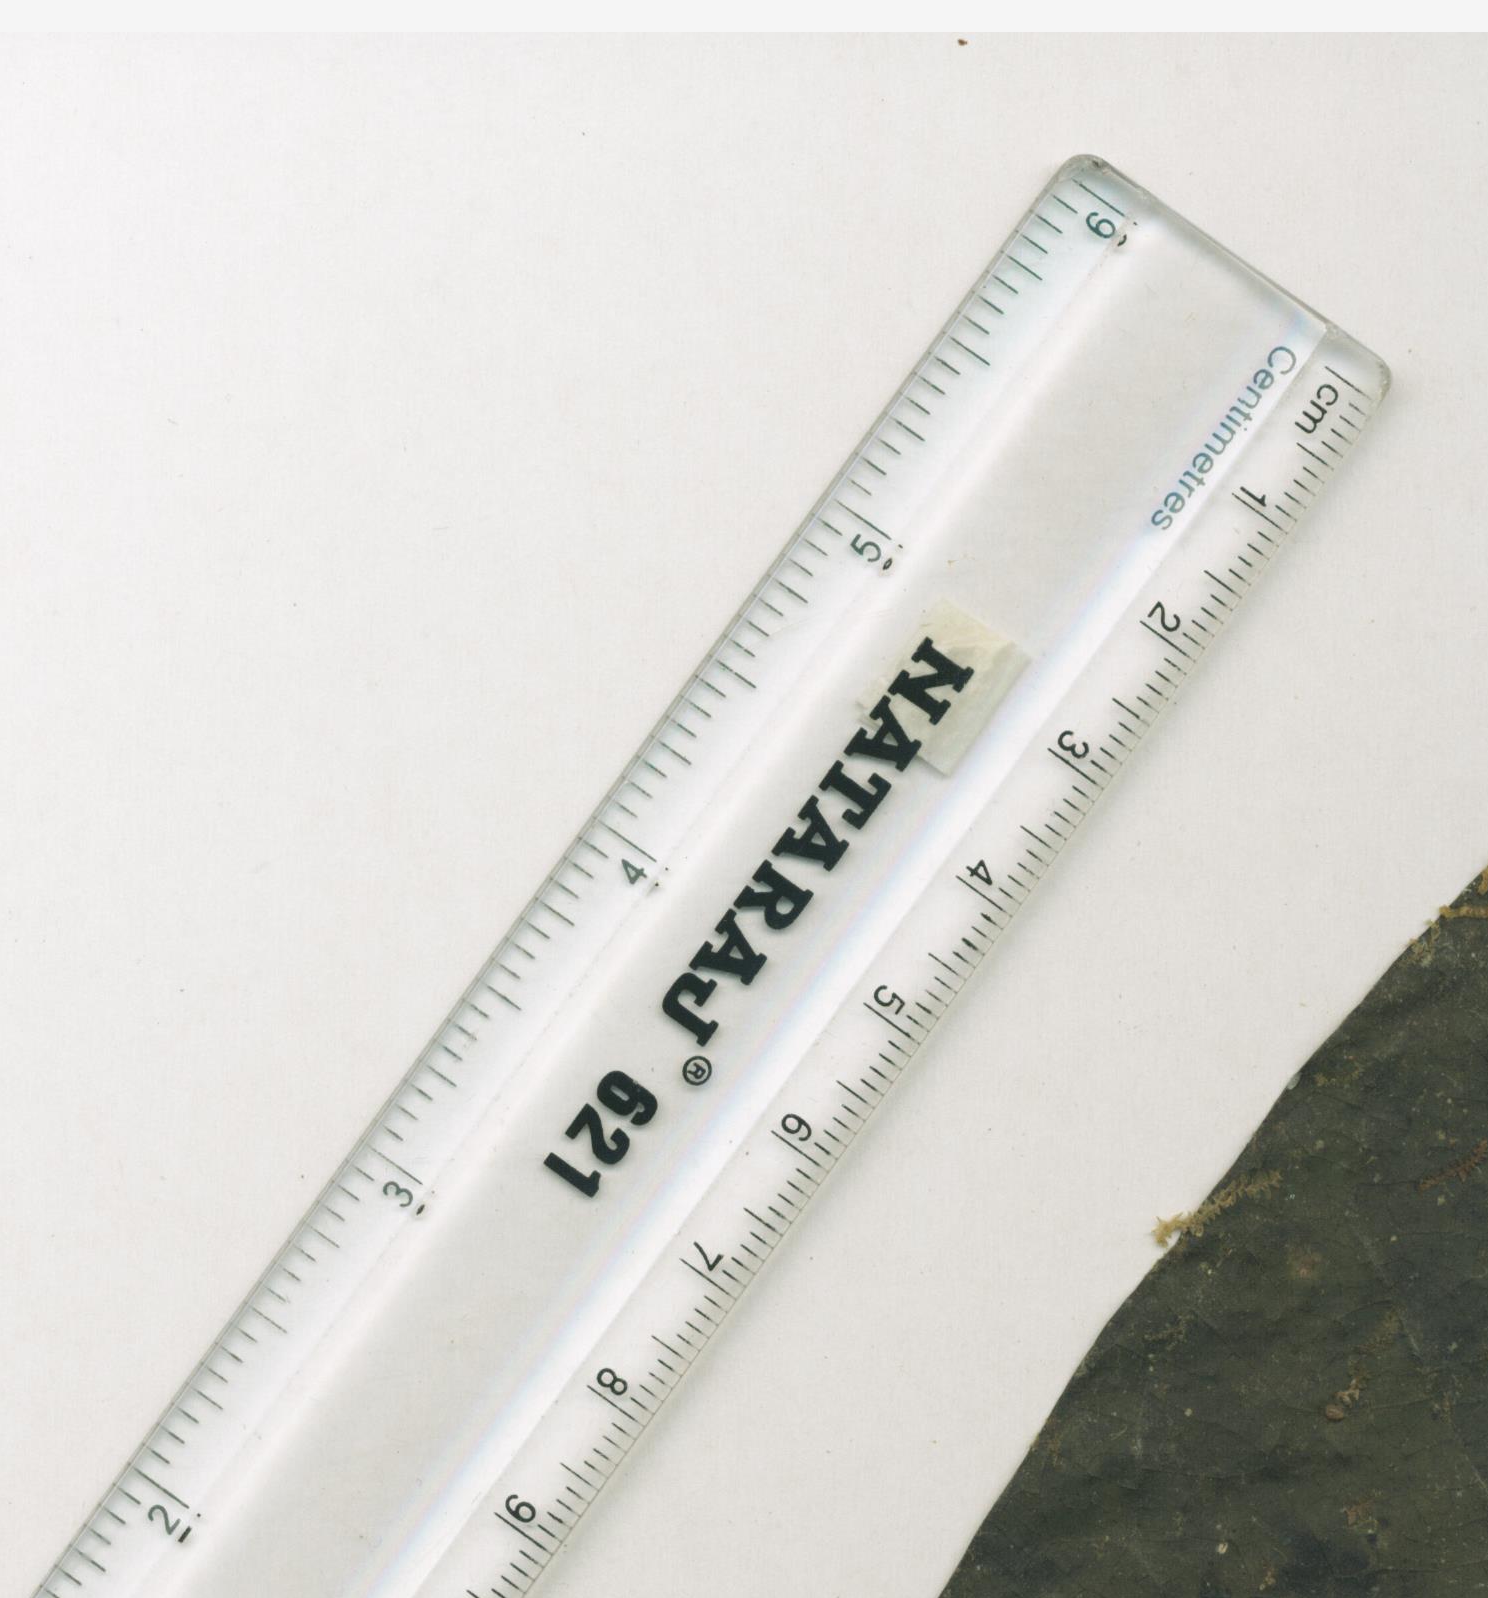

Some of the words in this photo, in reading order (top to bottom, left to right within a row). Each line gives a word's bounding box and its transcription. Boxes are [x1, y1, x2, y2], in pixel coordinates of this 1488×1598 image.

[1293, 383, 1340, 435] cm
[1150, 345, 1297, 531] Centimetres
[1238, 485, 1268, 507] 1
[849, 533, 882, 563] 5
[1146, 601, 1182, 634] 2
[1057, 729, 1091, 760] 3
[621, 858, 648, 886] 4
[966, 859, 994, 888] 4
[872, 985, 905, 1016] 5
[543, 1069, 659, 1198] 621
[780, 1113, 812, 1142] 6
[382, 1180, 412, 1208] 3
[694, 1241, 725, 1271] 7
[596, 1367, 628, 1396] 8
[147, 1503, 180, 1536] 2
[505, 1493, 537, 1524] 9
